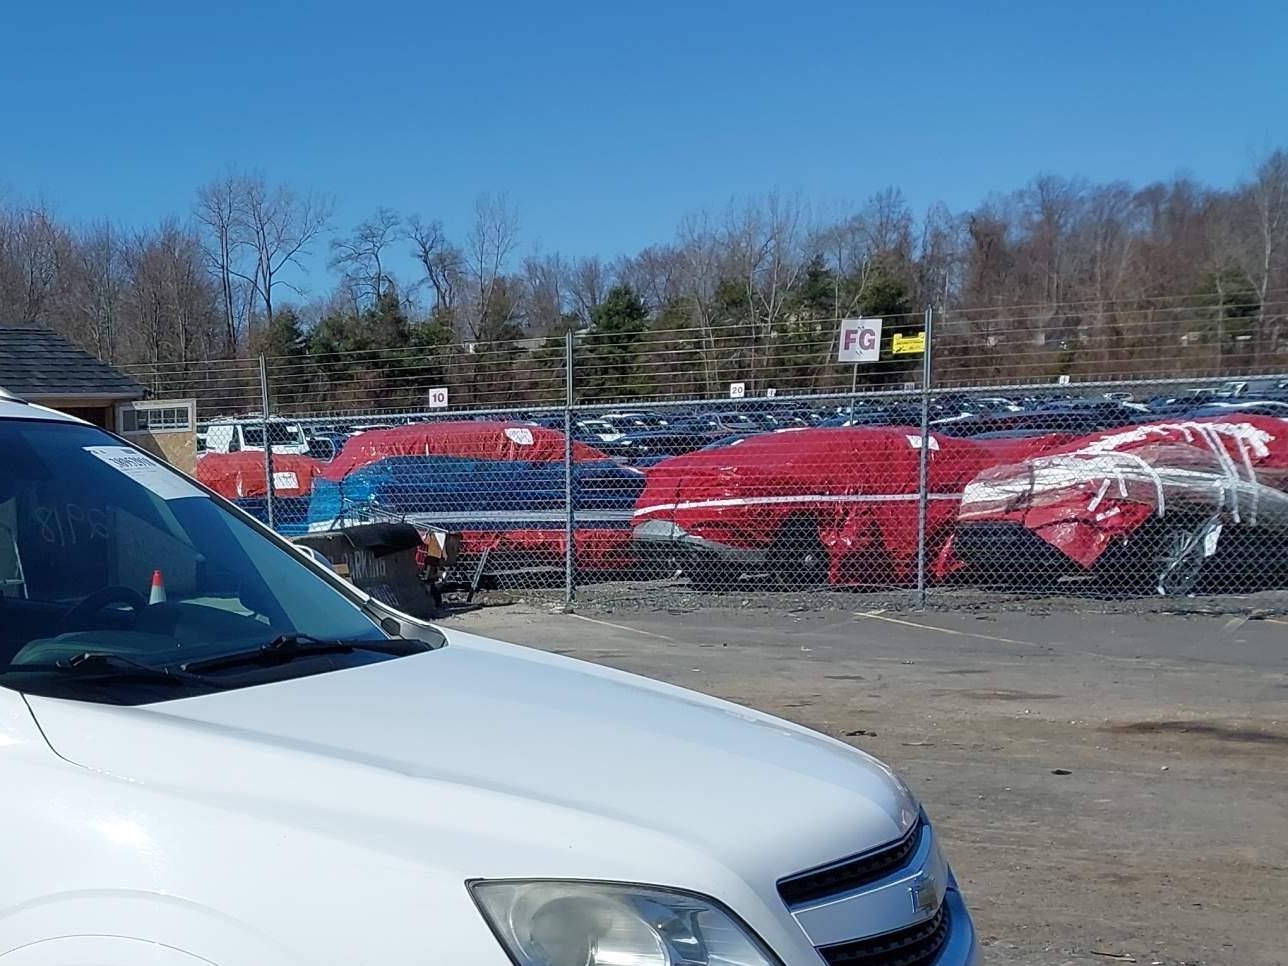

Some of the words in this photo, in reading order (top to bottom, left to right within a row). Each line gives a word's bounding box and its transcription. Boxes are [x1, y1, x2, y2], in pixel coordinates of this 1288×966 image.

[843, 328, 876, 351] FG
[731, 386, 743, 394] 20
[432, 392, 445, 403] 10
